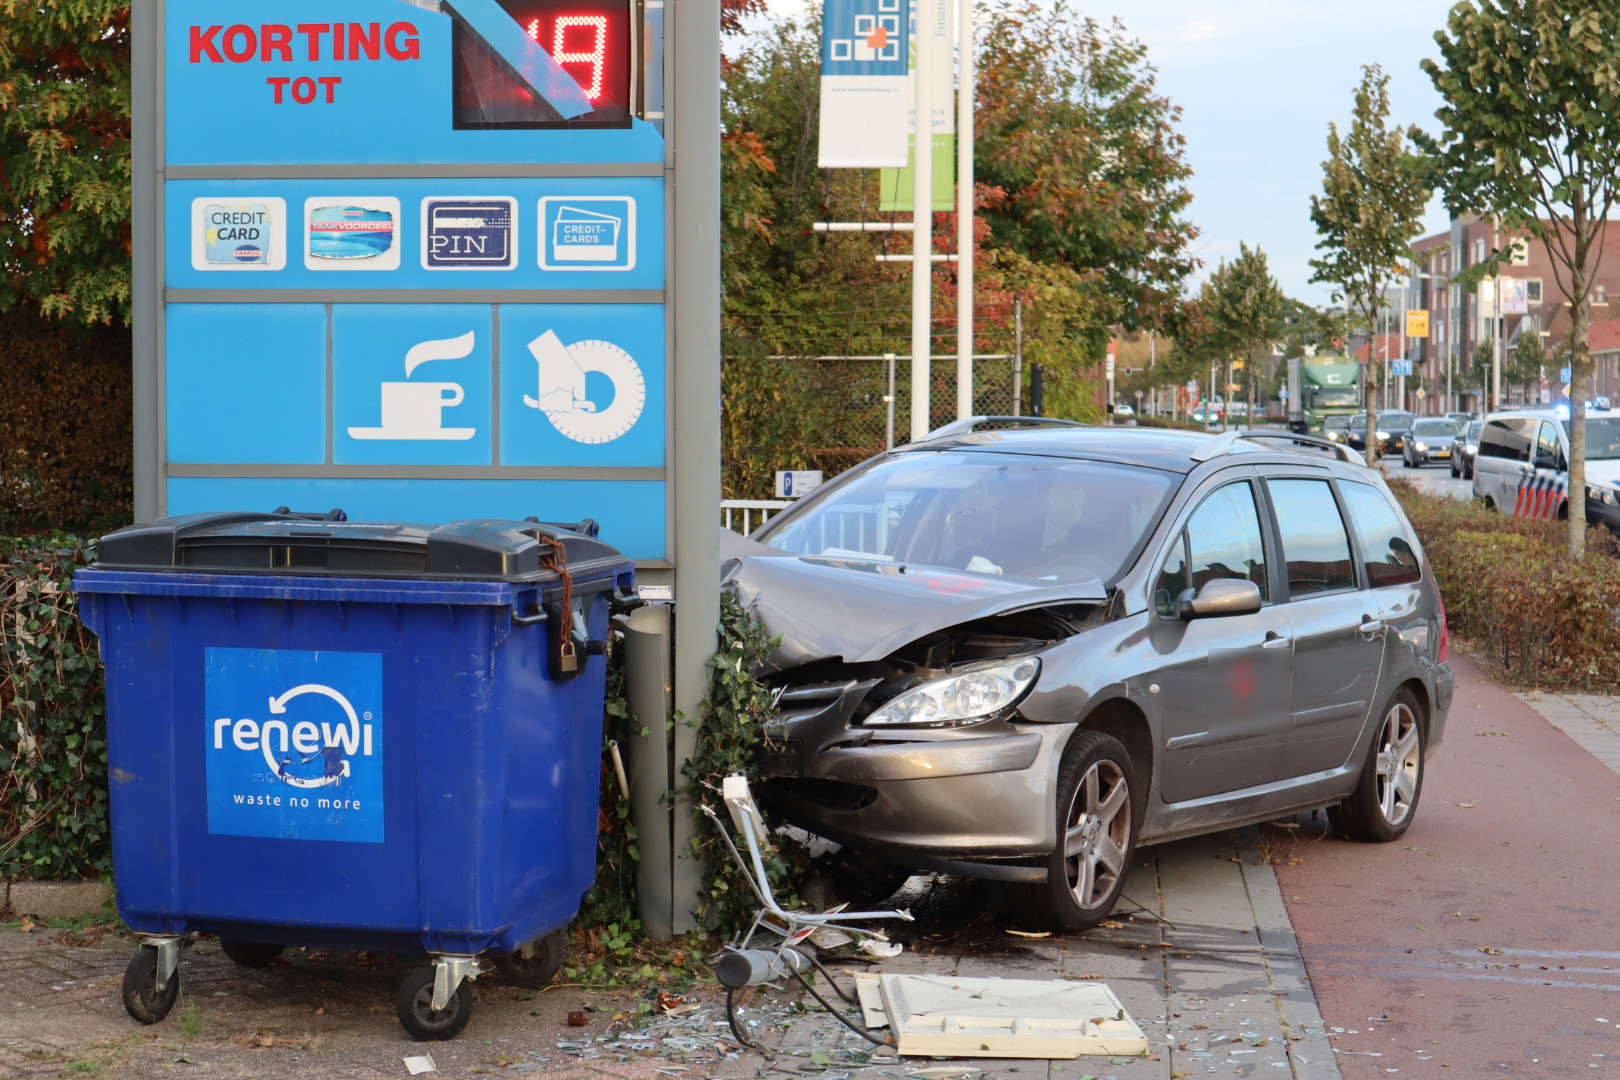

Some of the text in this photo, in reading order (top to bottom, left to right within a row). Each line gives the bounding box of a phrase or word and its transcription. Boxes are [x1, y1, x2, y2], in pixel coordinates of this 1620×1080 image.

[189, 22, 420, 63] KORTING
[266, 76, 342, 105] TOT
[211, 212, 266, 225] CREDIT
[217, 228, 260, 240] CARD
[564, 235, 600, 243] CARDS
[429, 235, 488, 253] PIN
[785, 477, 791, 491] P
[214, 711, 373, 756] renewi
[233, 794, 361, 810] waste no more
